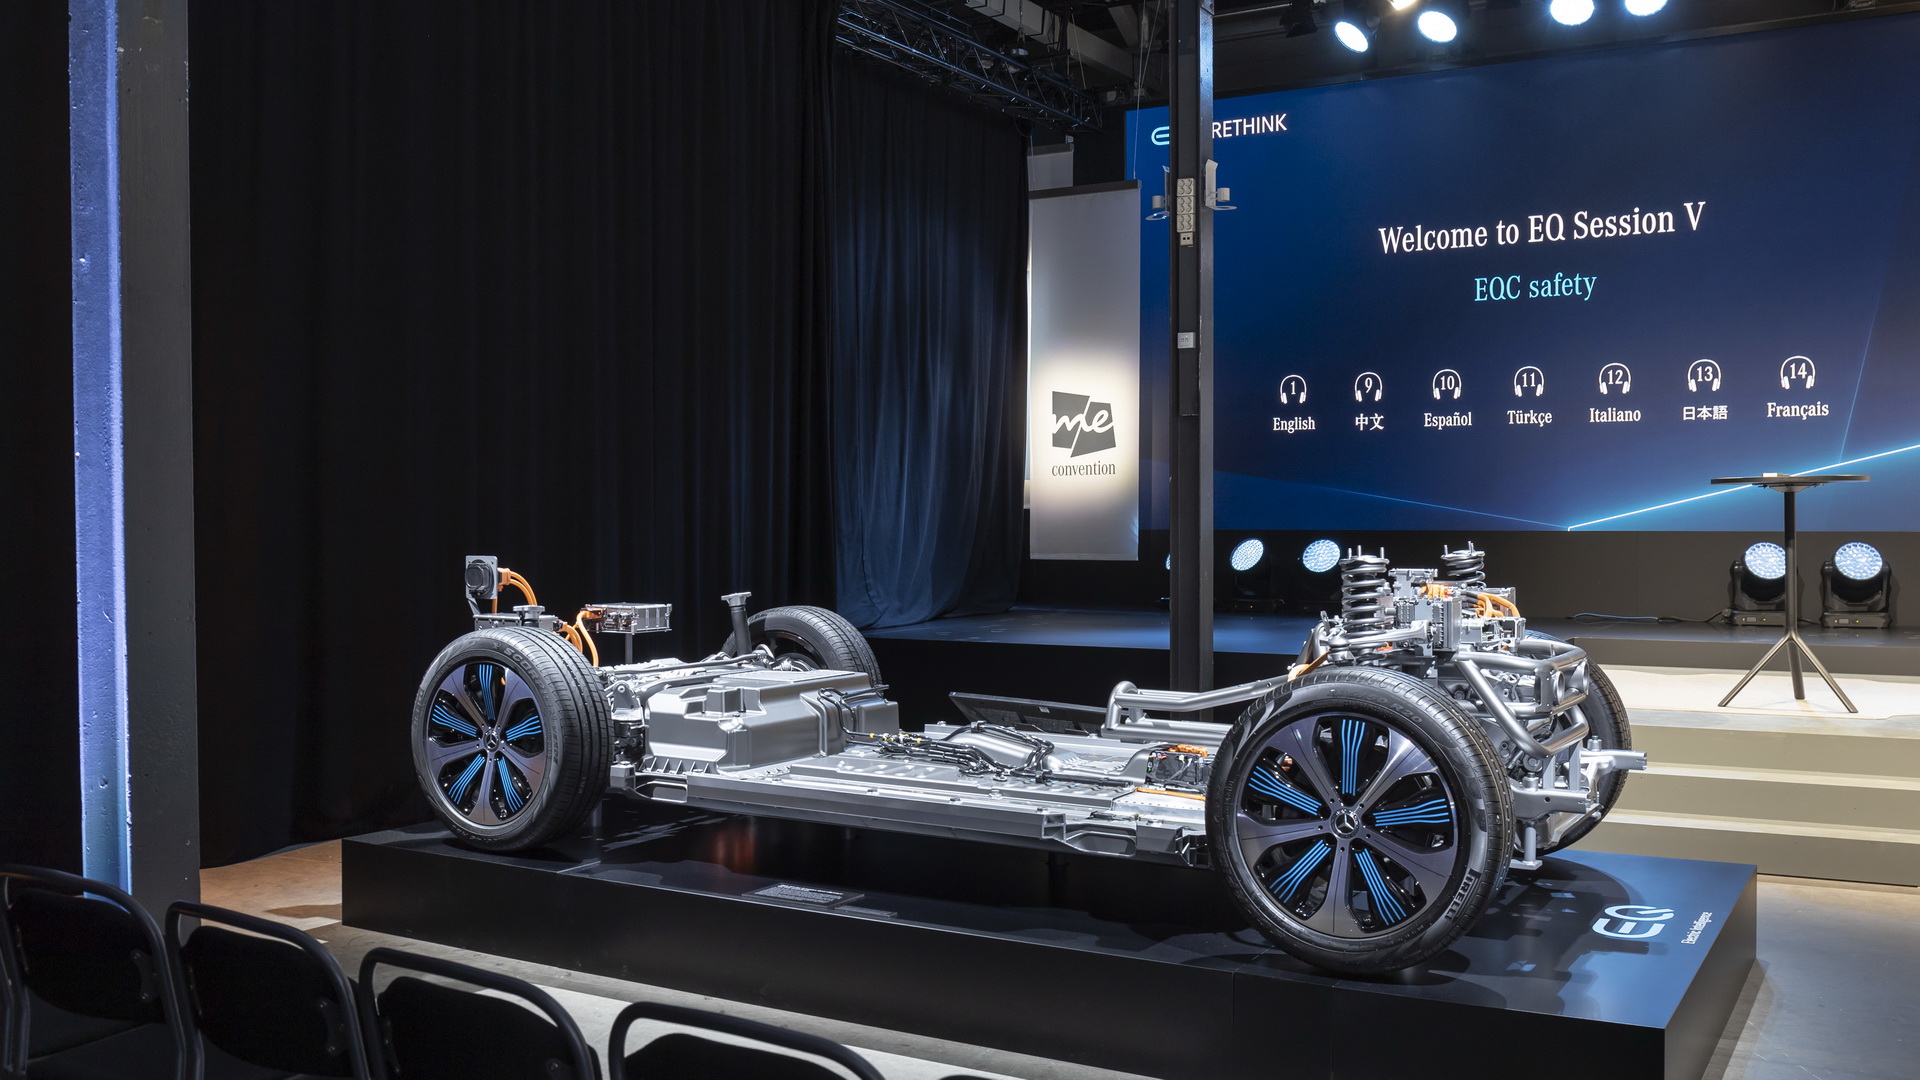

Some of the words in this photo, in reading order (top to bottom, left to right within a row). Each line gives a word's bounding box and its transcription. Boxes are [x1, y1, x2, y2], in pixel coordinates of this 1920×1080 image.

[1212, 113, 1288, 139] RETHINK
[1377, 224, 1488, 254] Welcome
[1495, 220, 1520, 246] to
[1527, 213, 1566, 243] EQ
[1573, 206, 1676, 240] Session
[1683, 200, 1706, 231] V
[1474, 274, 1521, 302] EQC
[1528, 271, 1598, 302] safety
[1521, 372, 1536, 388] 11
[1607, 369, 1624, 385] 12
[1696, 365, 1714, 382] 13
[1789, 362, 1808, 380] 14
[1290, 381, 1296, 395] 1
[1364, 377, 1373, 394] 9
[1439, 375, 1455, 391] 10
[1506, 409, 1553, 428] Türkçe
[1589, 406, 1642, 423] Italiano
[1682, 404, 1729, 421] 日本語
[1766, 400, 1830, 421] Français
[1052, 409, 1114, 434] me
[1272, 416, 1316, 434] English
[1355, 412, 1385, 431] 中文
[1424, 411, 1473, 431] Español
[1051, 460, 1116, 477] convention
[1592, 905, 1675, 939] EQ
